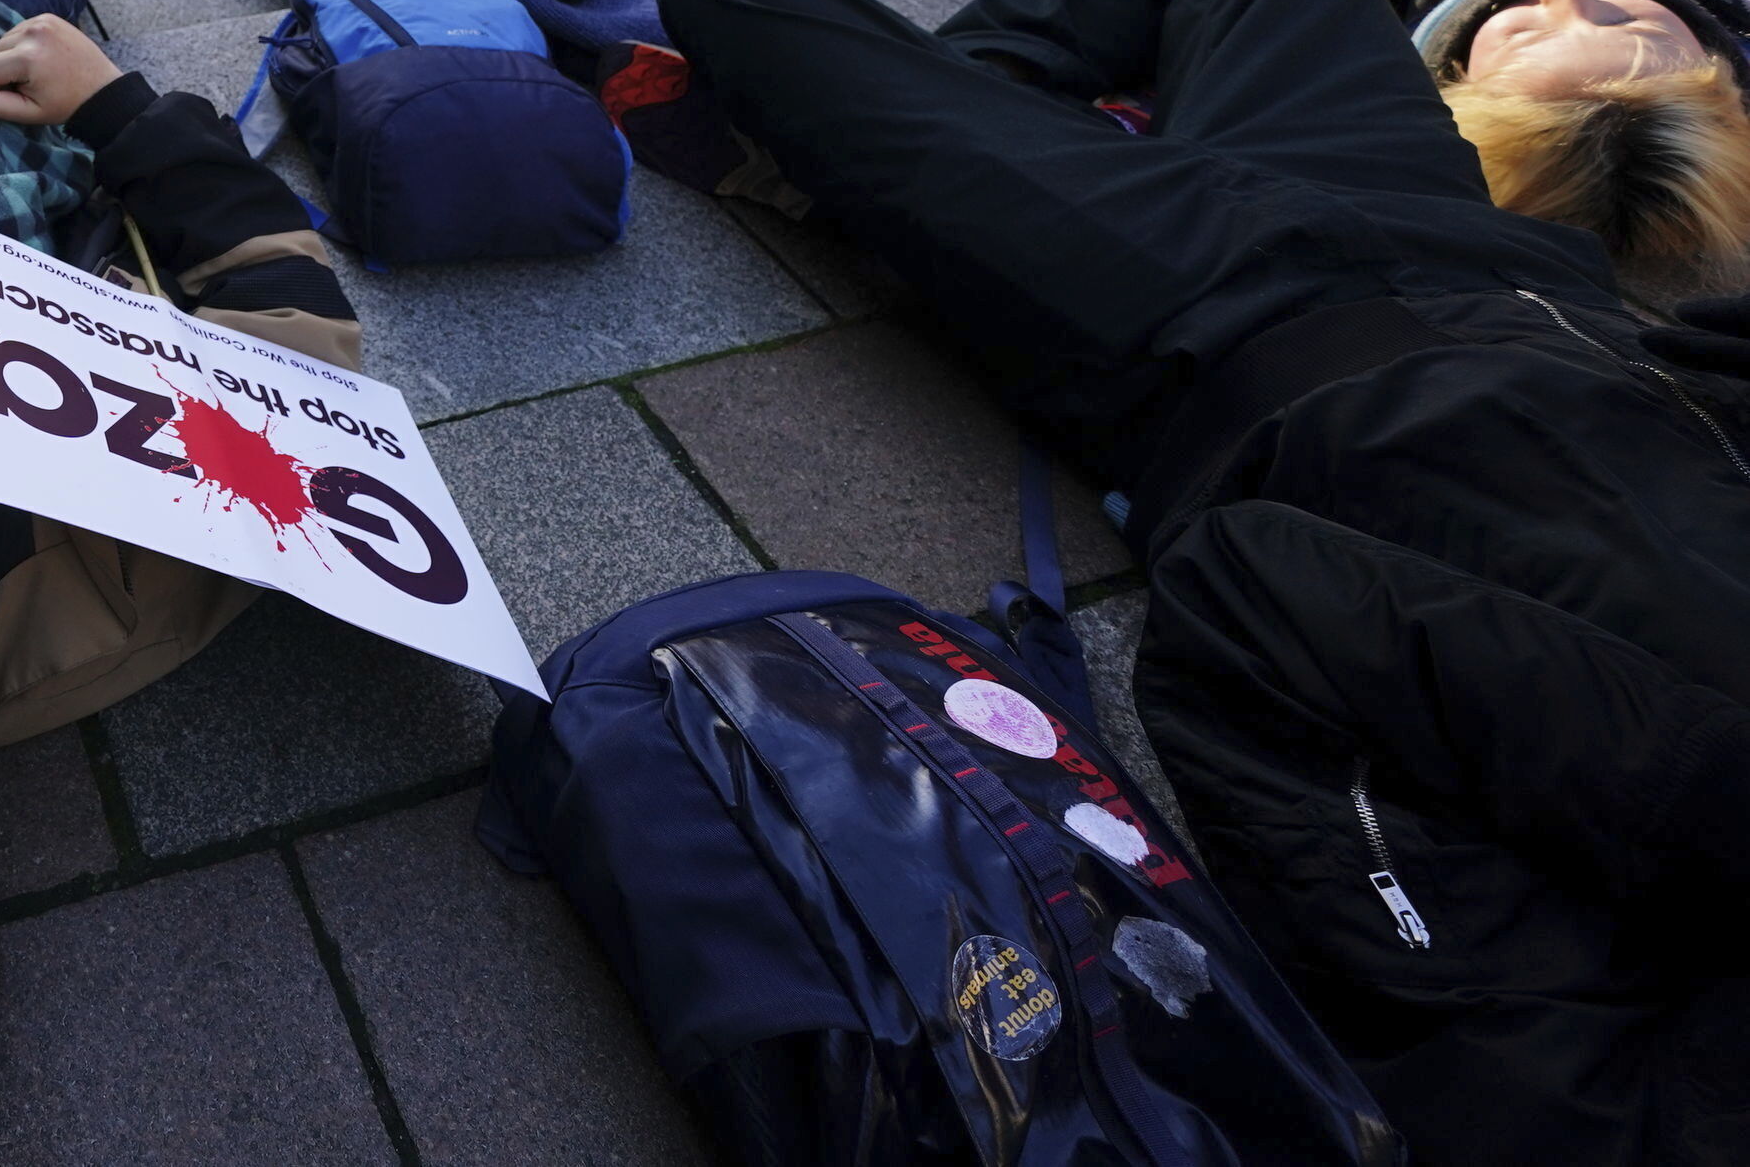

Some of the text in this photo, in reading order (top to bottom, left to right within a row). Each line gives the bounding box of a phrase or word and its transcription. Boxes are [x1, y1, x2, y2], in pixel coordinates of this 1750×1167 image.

[169, 309, 247, 352] Coalition
[251, 342, 288, 368] War
[290, 357, 315, 379] the
[213, 367, 290, 419] the
[320, 366, 360, 393] Stop
[300, 395, 407, 461] Stop
[959, 946, 1020, 1010] animals
[1000, 967, 1037, 1000] eat
[997, 988, 1056, 1038] donut
